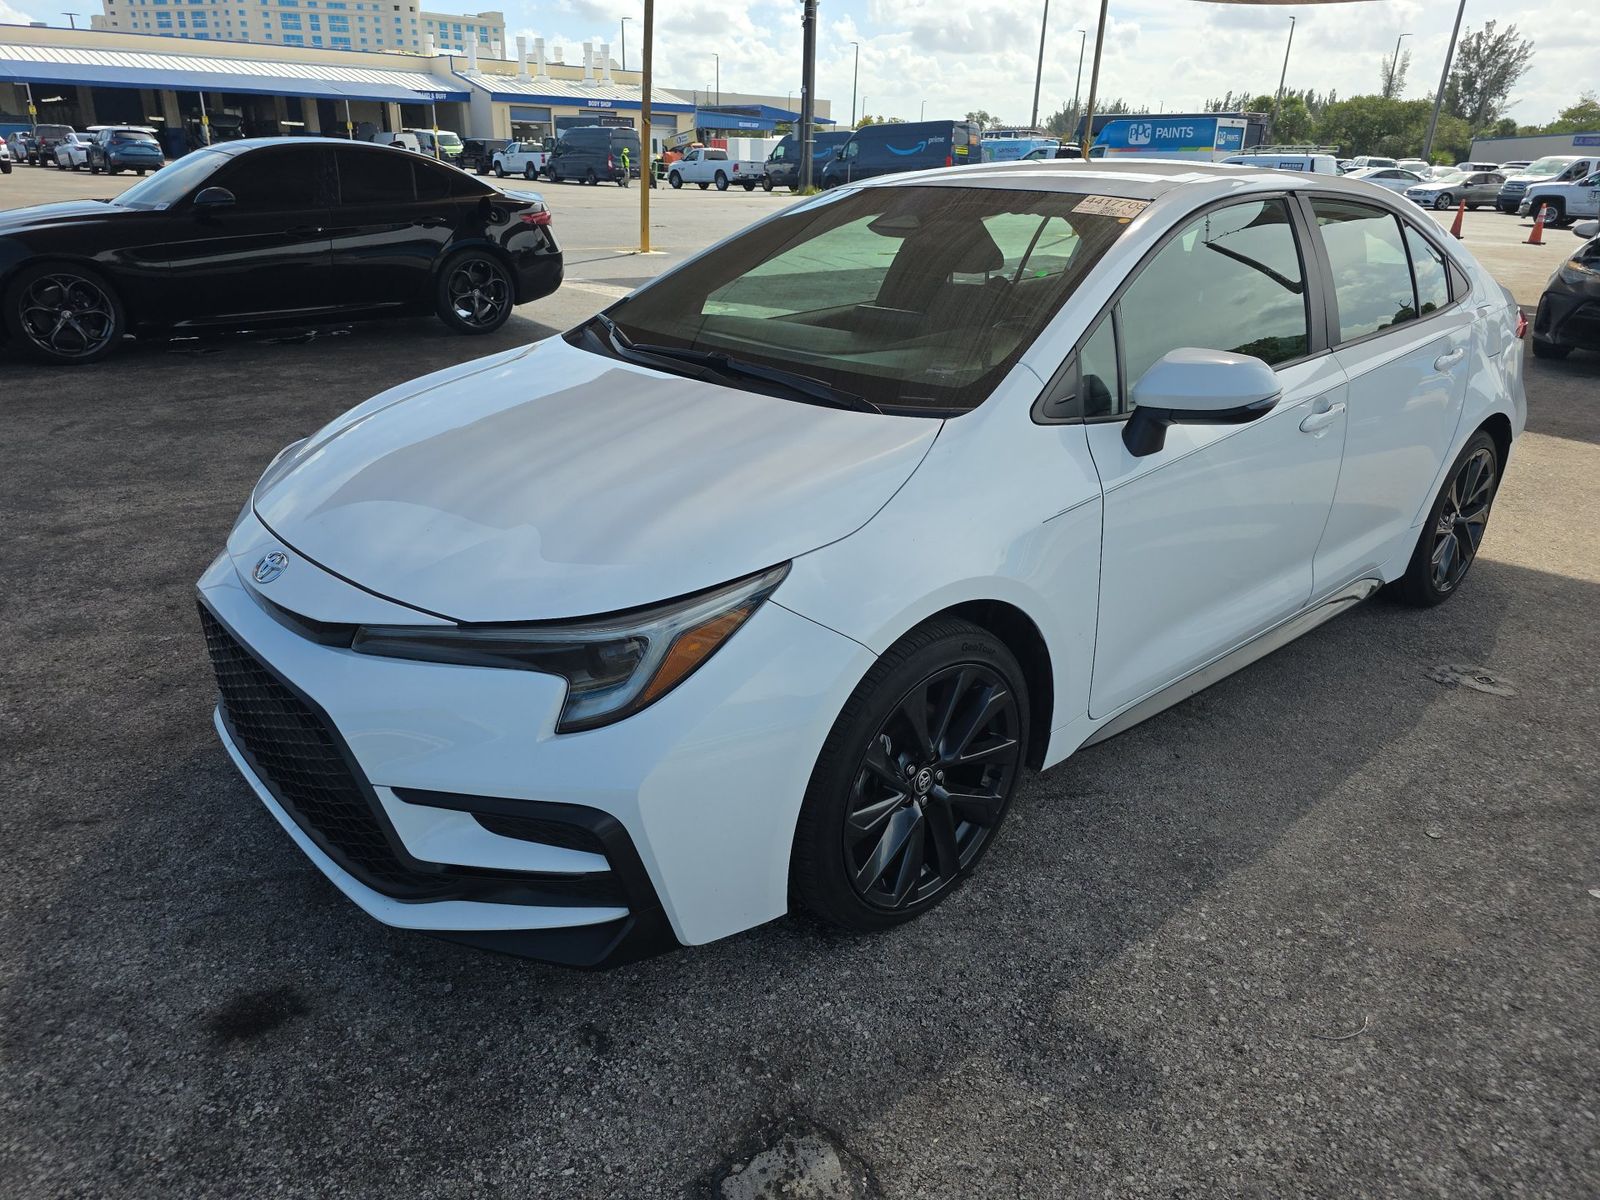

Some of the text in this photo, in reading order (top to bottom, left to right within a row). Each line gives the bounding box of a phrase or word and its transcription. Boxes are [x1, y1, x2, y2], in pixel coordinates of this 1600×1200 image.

[928, 136, 945, 144] prime
[1128, 124, 1194, 144] PPG PAINTS
